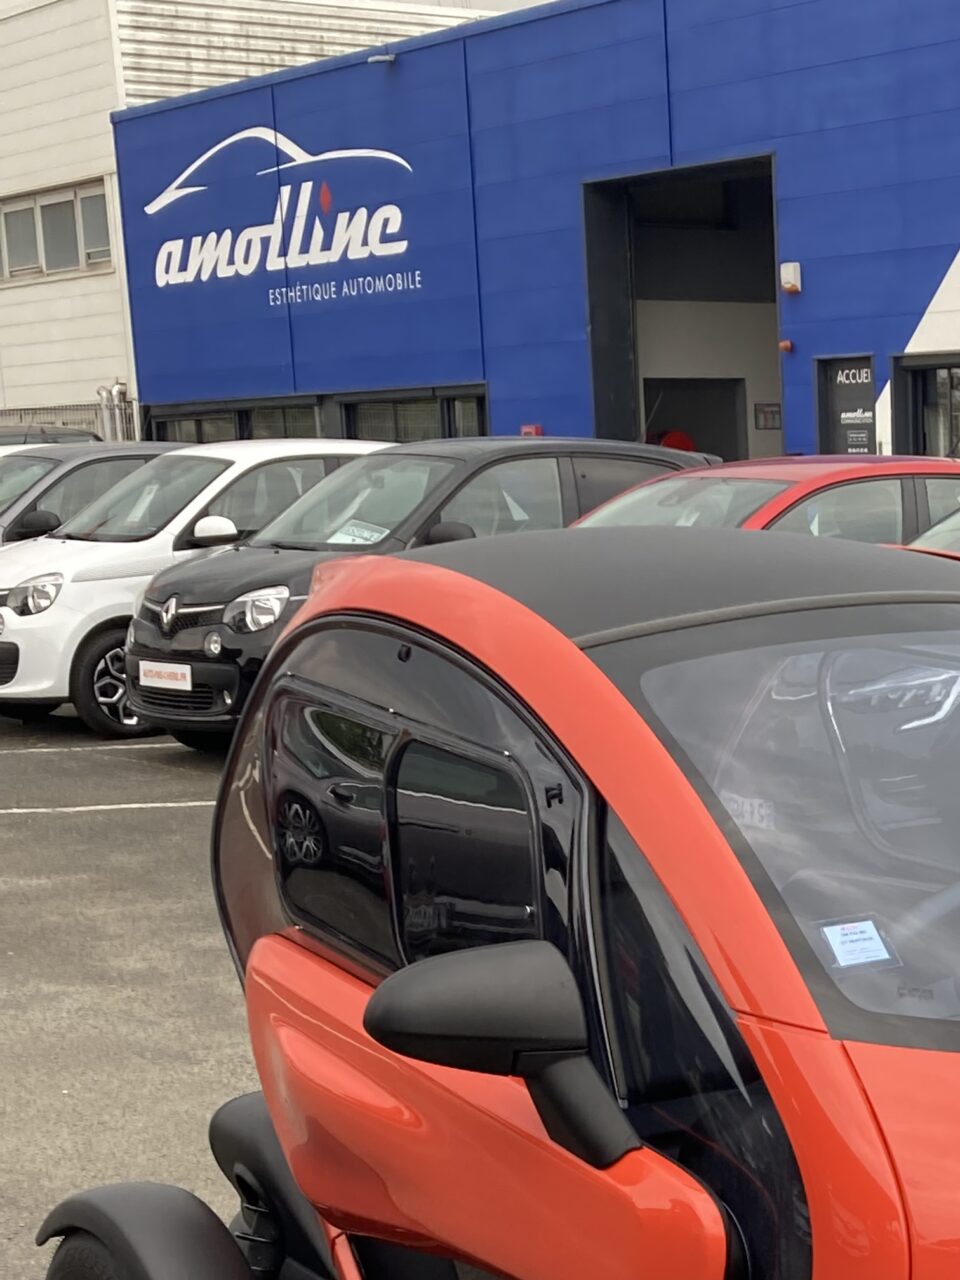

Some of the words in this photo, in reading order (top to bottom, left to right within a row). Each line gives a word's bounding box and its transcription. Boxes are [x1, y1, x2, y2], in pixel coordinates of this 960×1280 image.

[268, 280, 337, 306] ESTHÉTIQUE
[341, 270, 423, 297] AUTOMOBILE
[837, 368, 871, 384] ACCUEI
